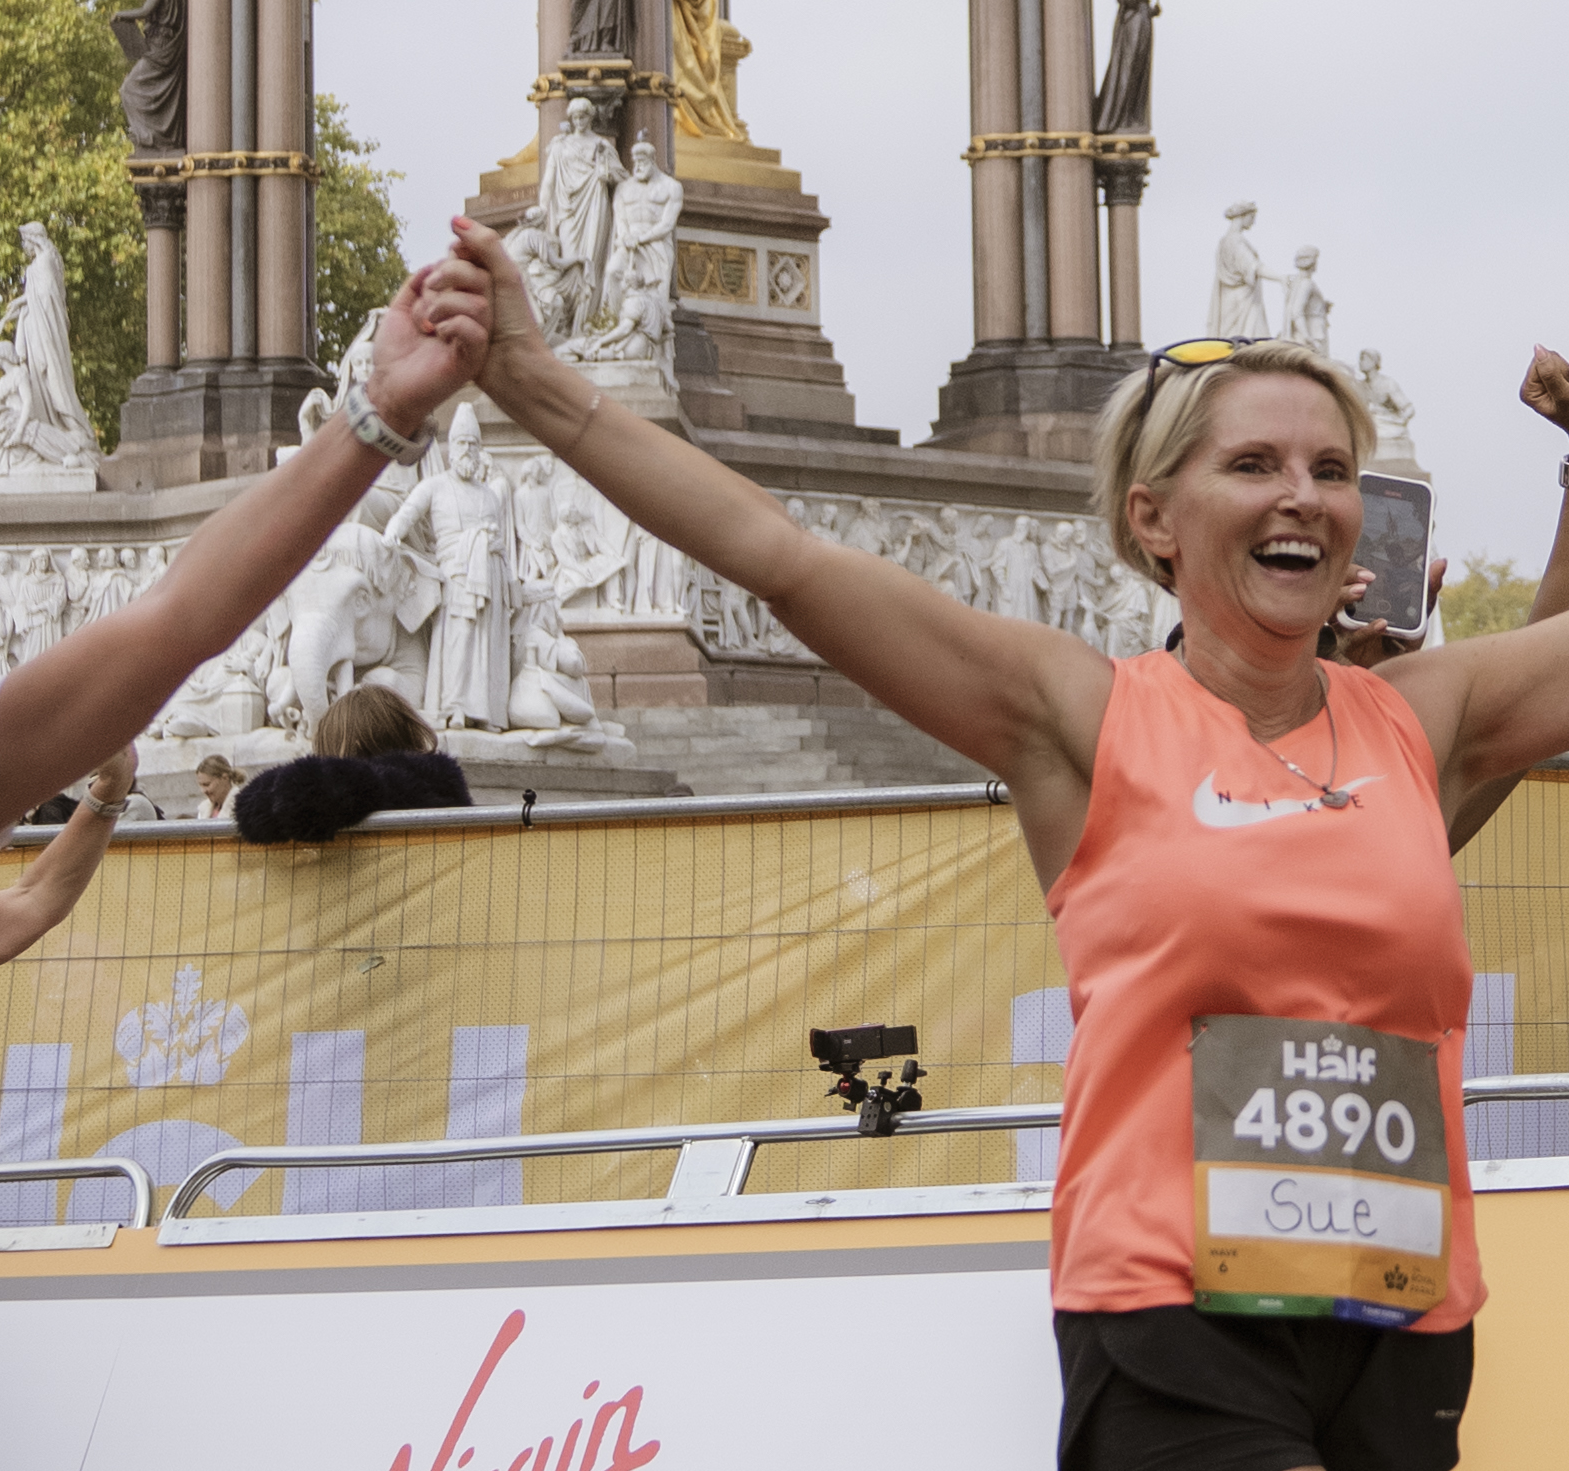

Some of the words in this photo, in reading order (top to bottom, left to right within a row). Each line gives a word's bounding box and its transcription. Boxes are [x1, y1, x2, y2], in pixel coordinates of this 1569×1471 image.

[1283, 1040, 1377, 1084] Half
[1234, 1087, 1416, 1165] 4890
[1265, 1178, 1378, 1237] Sue
